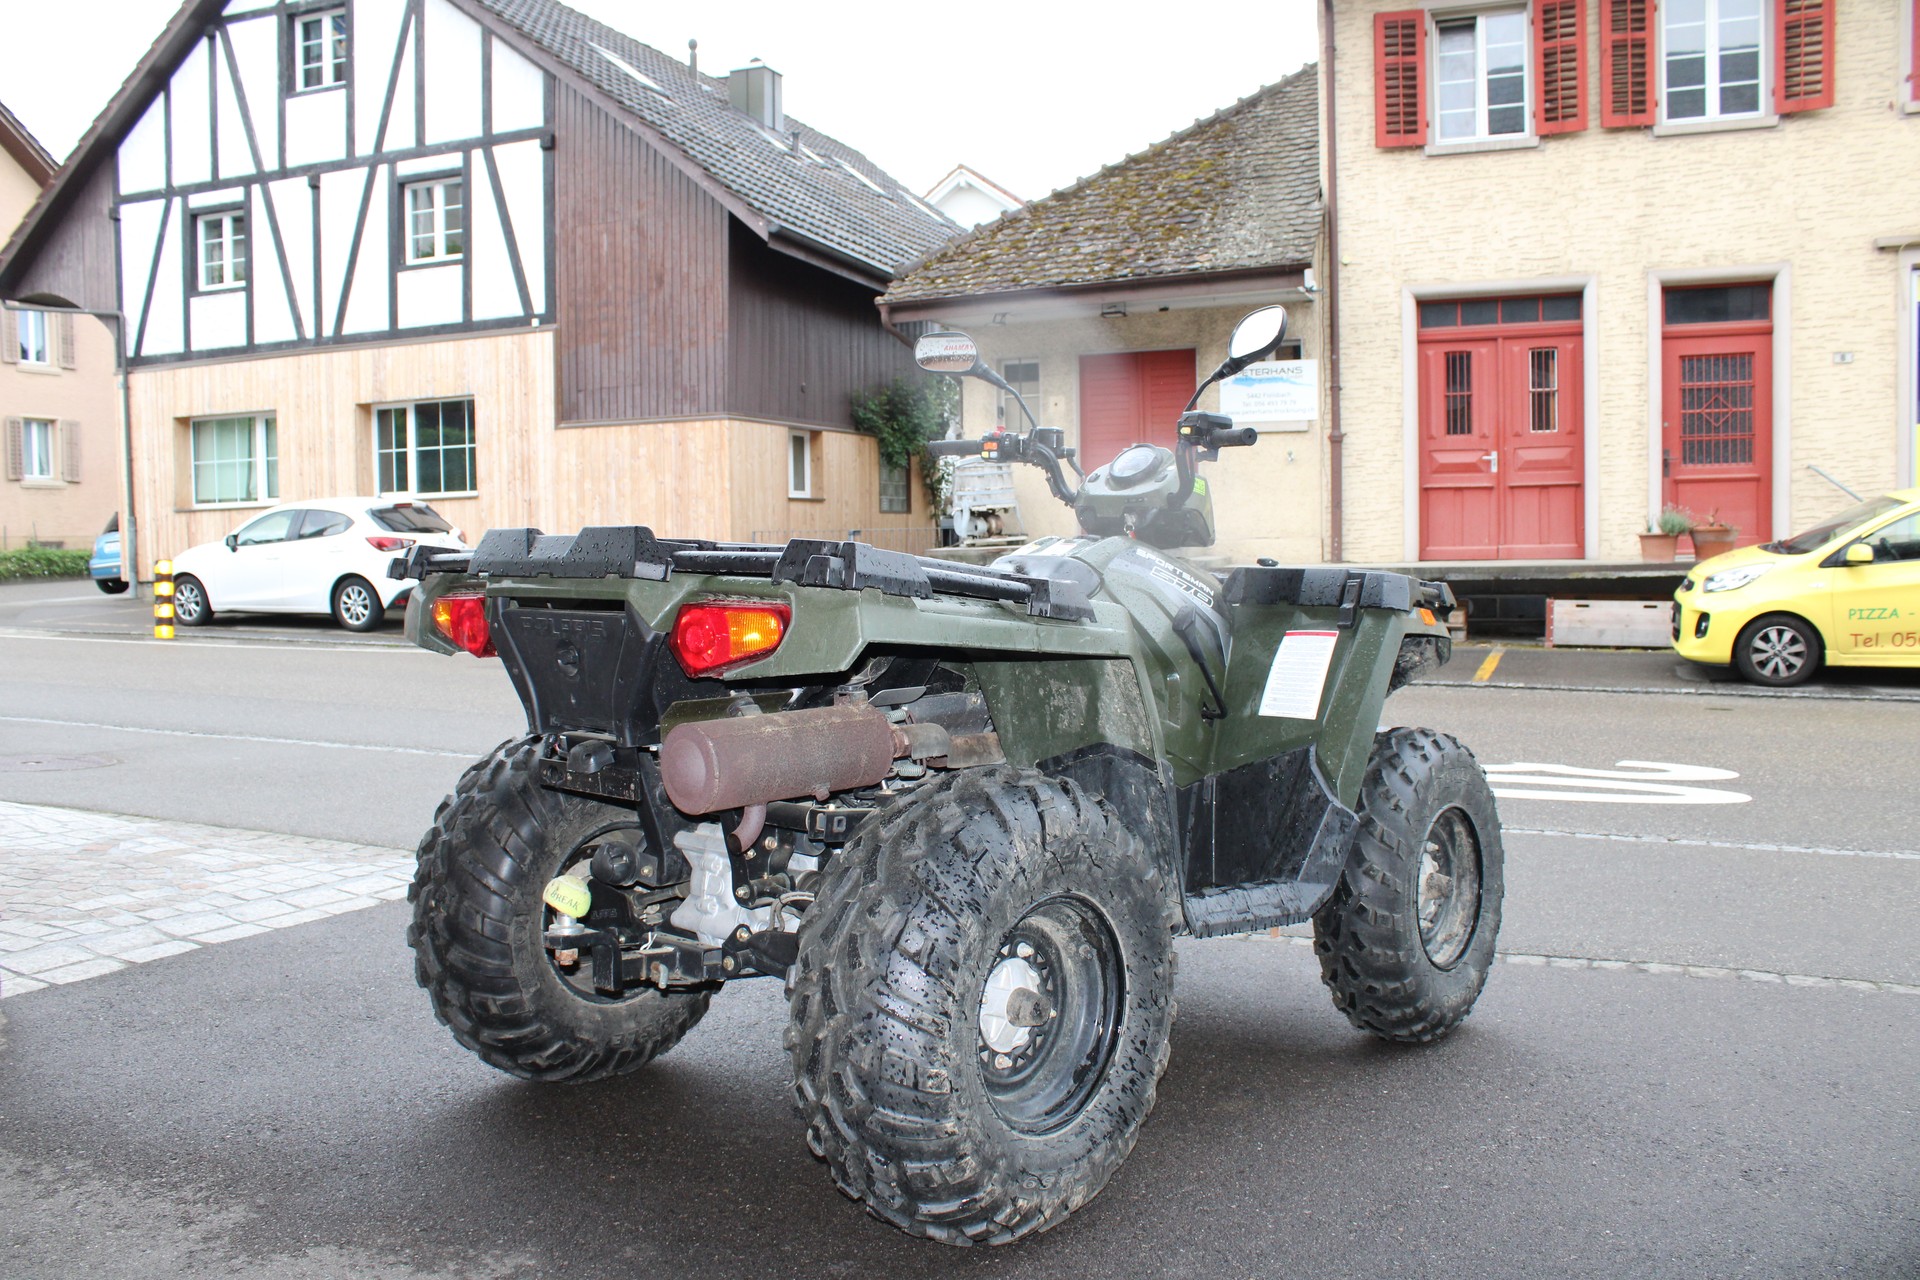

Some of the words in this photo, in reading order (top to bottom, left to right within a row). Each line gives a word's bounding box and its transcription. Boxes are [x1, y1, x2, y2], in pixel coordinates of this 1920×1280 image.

[1136, 548, 1214, 596] SPORTSMAN
[1151, 566, 1214, 608] 570
[1848, 607, 1899, 620] PIZZA
[1850, 632, 1884, 648] Tel.
[1891, 632, 1920, 648] 05
